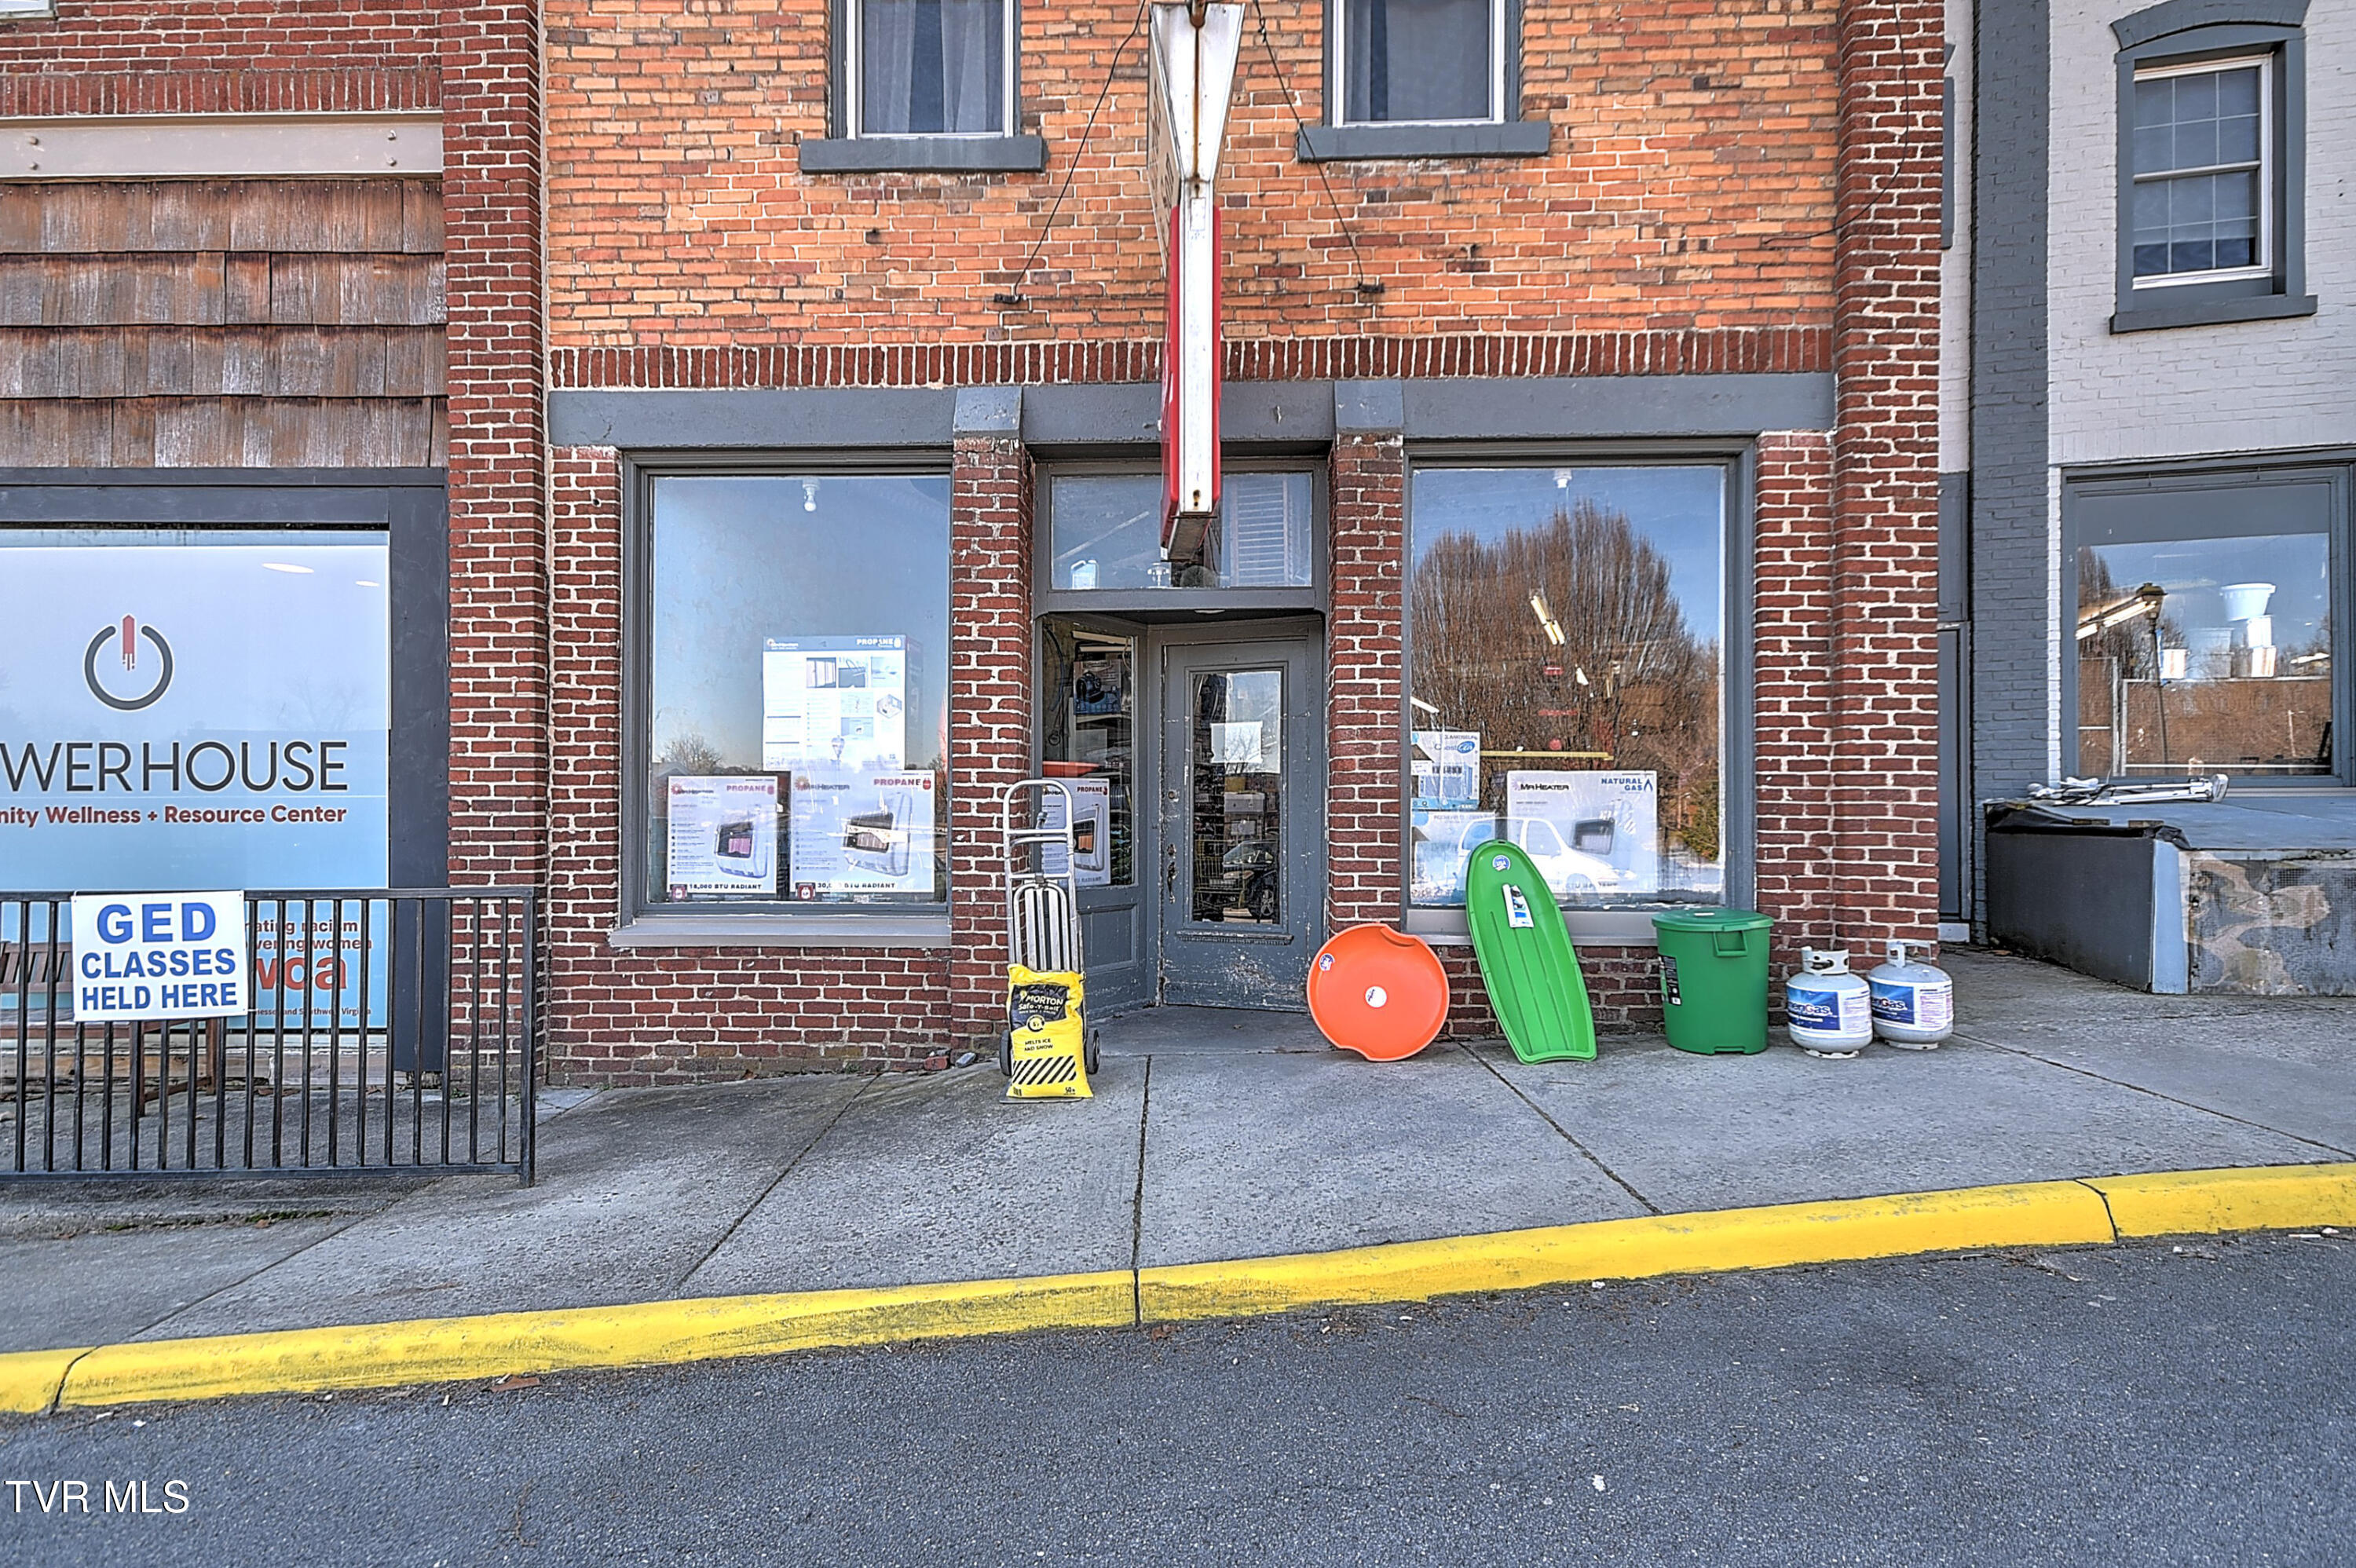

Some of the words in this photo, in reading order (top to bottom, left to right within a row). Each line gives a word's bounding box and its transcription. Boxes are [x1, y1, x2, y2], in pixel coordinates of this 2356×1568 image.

[0, 740, 348, 792] WERHOUSE
[45, 806, 141, 824] Wellness
[164, 806, 265, 824] Resource
[271, 806, 347, 824] Center
[97, 902, 216, 944] GED
[245, 919, 295, 934] atig
[302, 919, 358, 932] racim
[82, 948, 236, 978] CLASSES
[82, 985, 151, 1011] HELD
[161, 982, 237, 1008] HERE
[1026, 995, 1063, 1006] MORTON
[342, 1007, 371, 1017] Virgia
